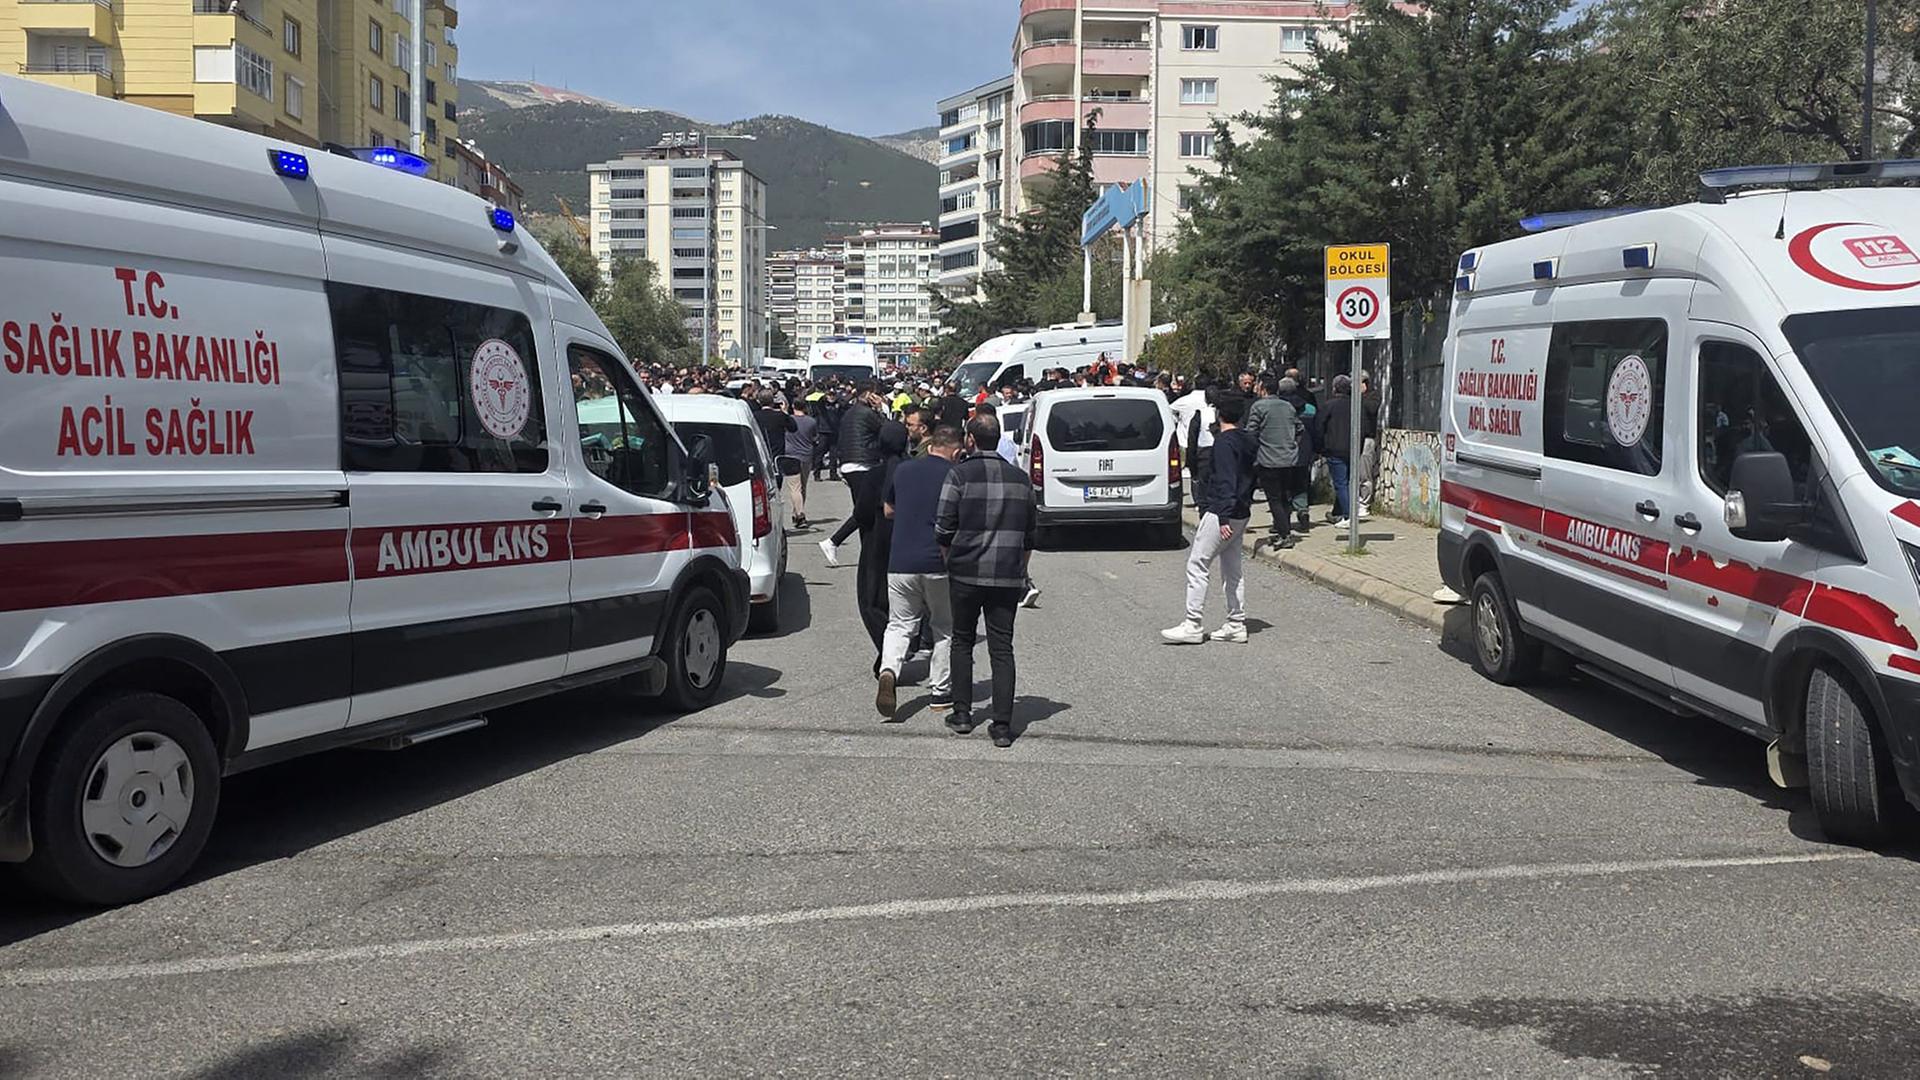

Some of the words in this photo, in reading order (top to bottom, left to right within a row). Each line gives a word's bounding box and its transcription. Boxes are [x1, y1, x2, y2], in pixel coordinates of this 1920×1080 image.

[1339, 251, 1375, 261] OKUL
[1853, 240, 1903, 255] 112
[1330, 261, 1386, 275] BÖLGESİ
[116, 268, 179, 319] T.C.
[1345, 298, 1370, 317] 30
[3, 312, 125, 378] SAĞLIK
[134, 330, 280, 385] BAKANLIĞI
[1490, 338, 1506, 364] T.C.
[1458, 368, 1487, 397] SAĞLIK
[1487, 368, 1538, 401] BAKANLIĞI
[57, 394, 136, 456] ACİL
[146, 397, 255, 455] SAĞLIK
[1468, 402, 1487, 431] ACİL
[1489, 404, 1522, 436] SAĞLIK
[1098, 459, 1114, 471] FIAT
[377, 523, 550, 573] AMBULANS
[1567, 519, 1641, 561] AMBULANS
